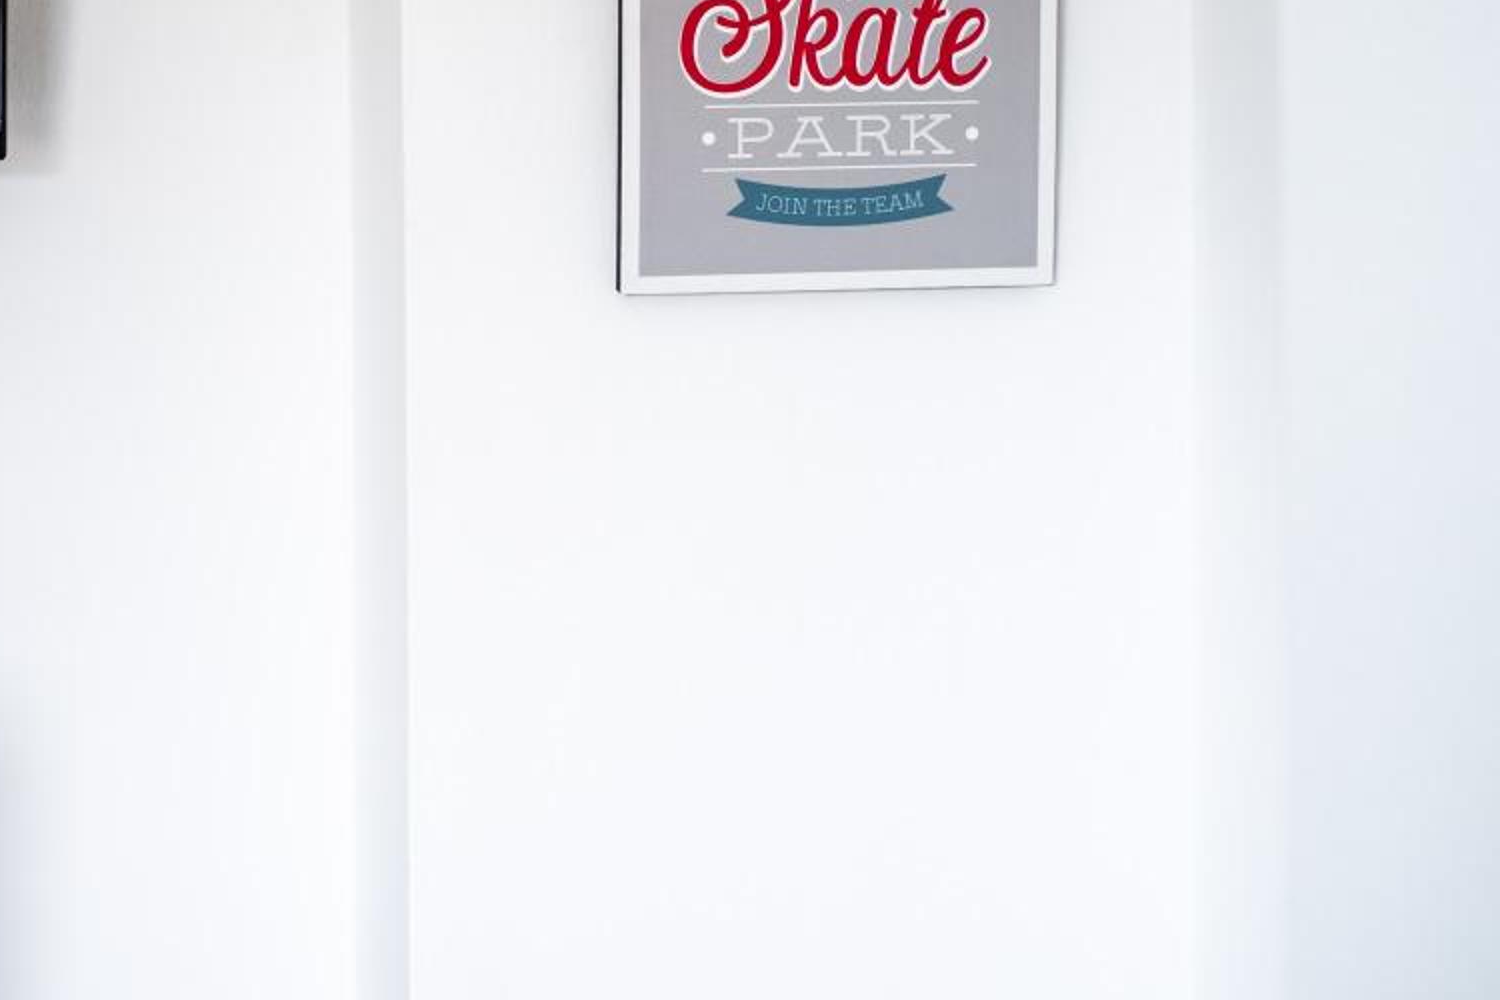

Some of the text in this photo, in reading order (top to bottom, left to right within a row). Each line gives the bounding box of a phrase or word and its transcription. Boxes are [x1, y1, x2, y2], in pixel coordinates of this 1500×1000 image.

[727, 113, 954, 159] PARK
[755, 191, 925, 217] JOIN THE TEAM
